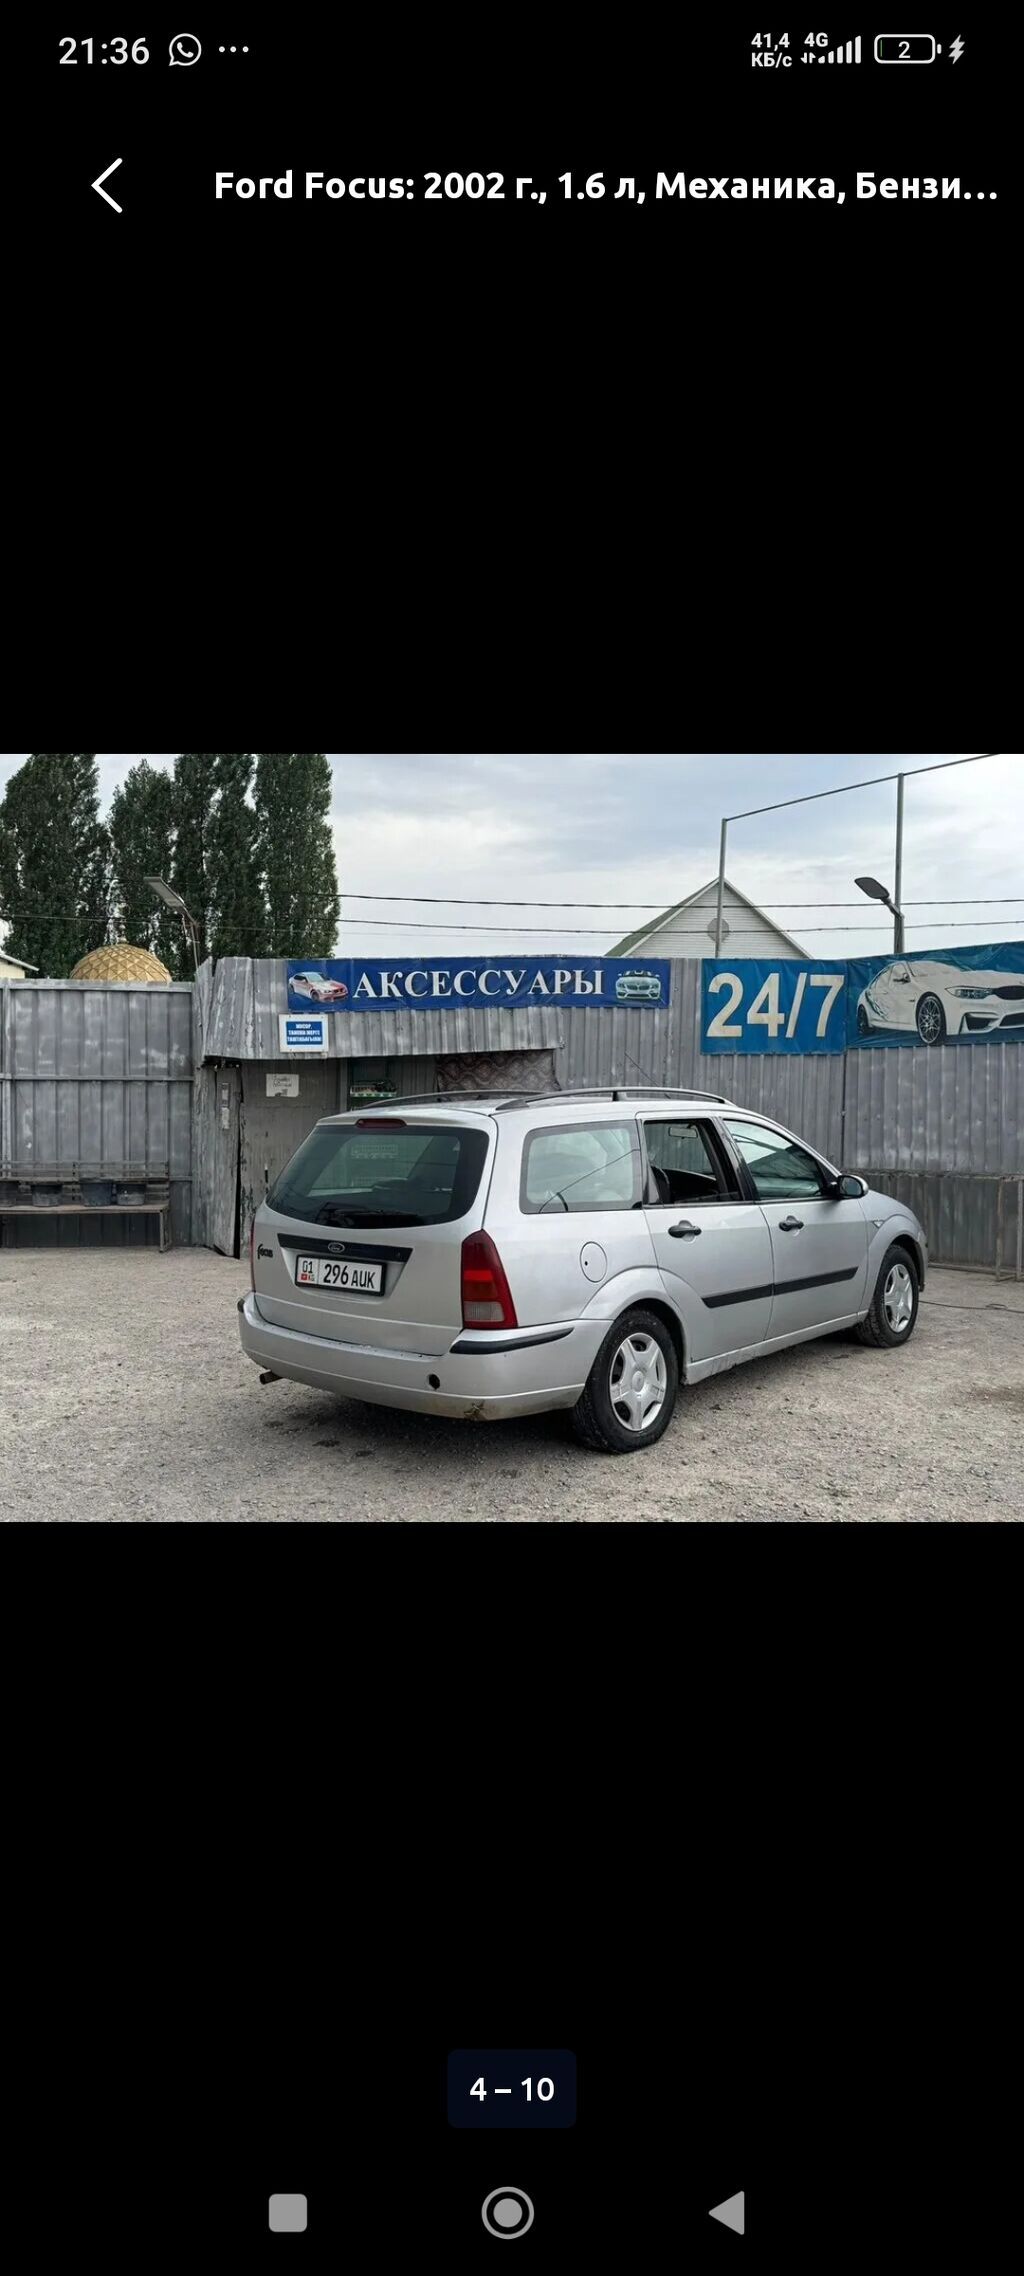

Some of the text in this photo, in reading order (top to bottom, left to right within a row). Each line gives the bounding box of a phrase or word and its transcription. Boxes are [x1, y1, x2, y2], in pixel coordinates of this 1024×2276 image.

[352, 968, 603, 1000] АКСЕССУАРЫ
[706, 972, 845, 1039] 24/7
[323, 1263, 349, 1285] 296
[350, 1269, 376, 1289] AUK
